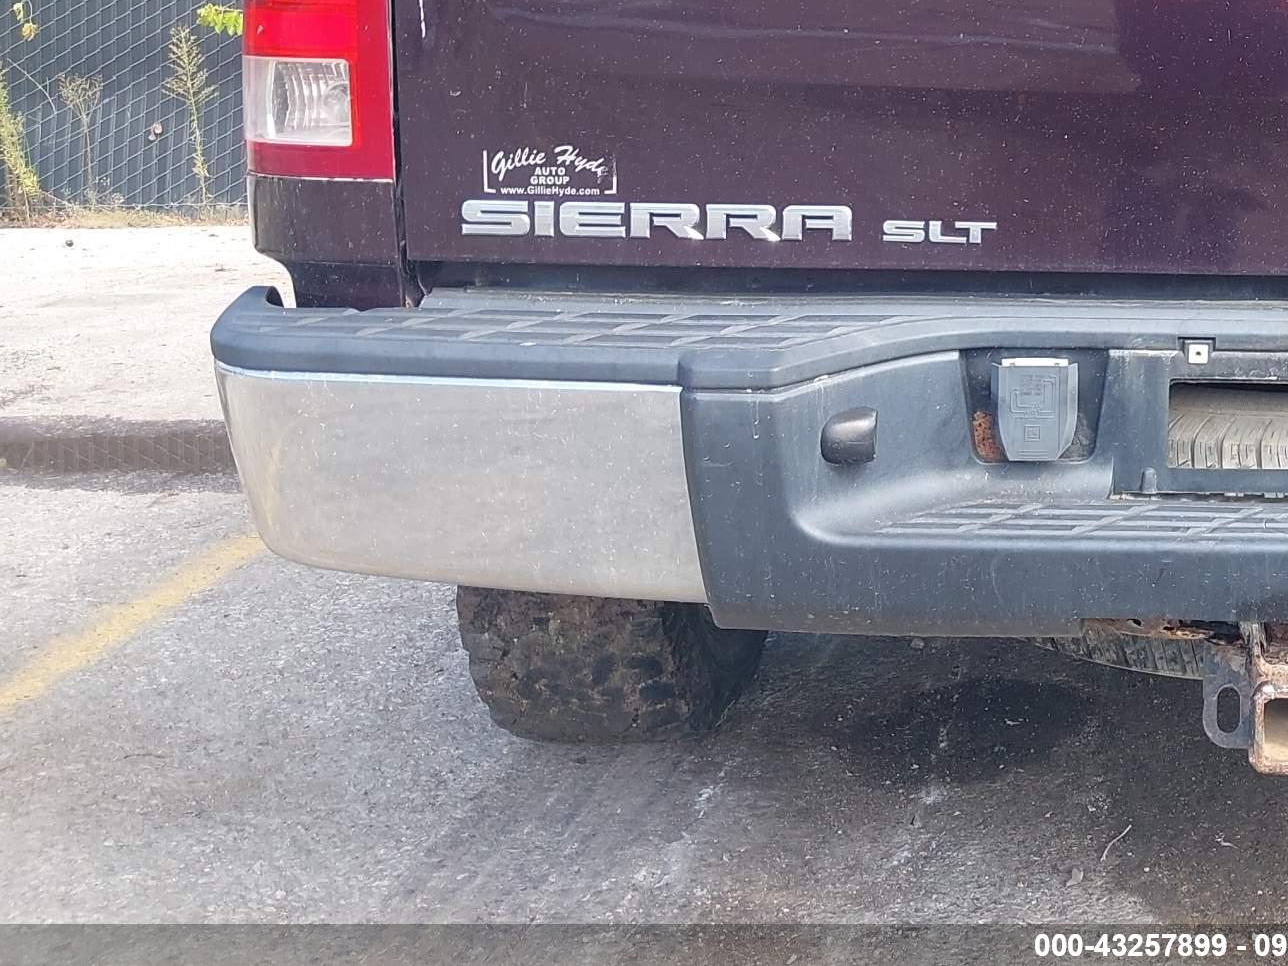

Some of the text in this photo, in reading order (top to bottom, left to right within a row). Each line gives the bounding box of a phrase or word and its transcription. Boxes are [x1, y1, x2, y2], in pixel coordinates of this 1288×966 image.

[491, 147, 546, 181] Gillie
[534, 167, 566, 176] AUTO
[530, 176, 570, 185] GROUP
[500, 186, 600, 196] www.GillieHyde.com
[461, 199, 997, 243] SIERRA SLT
